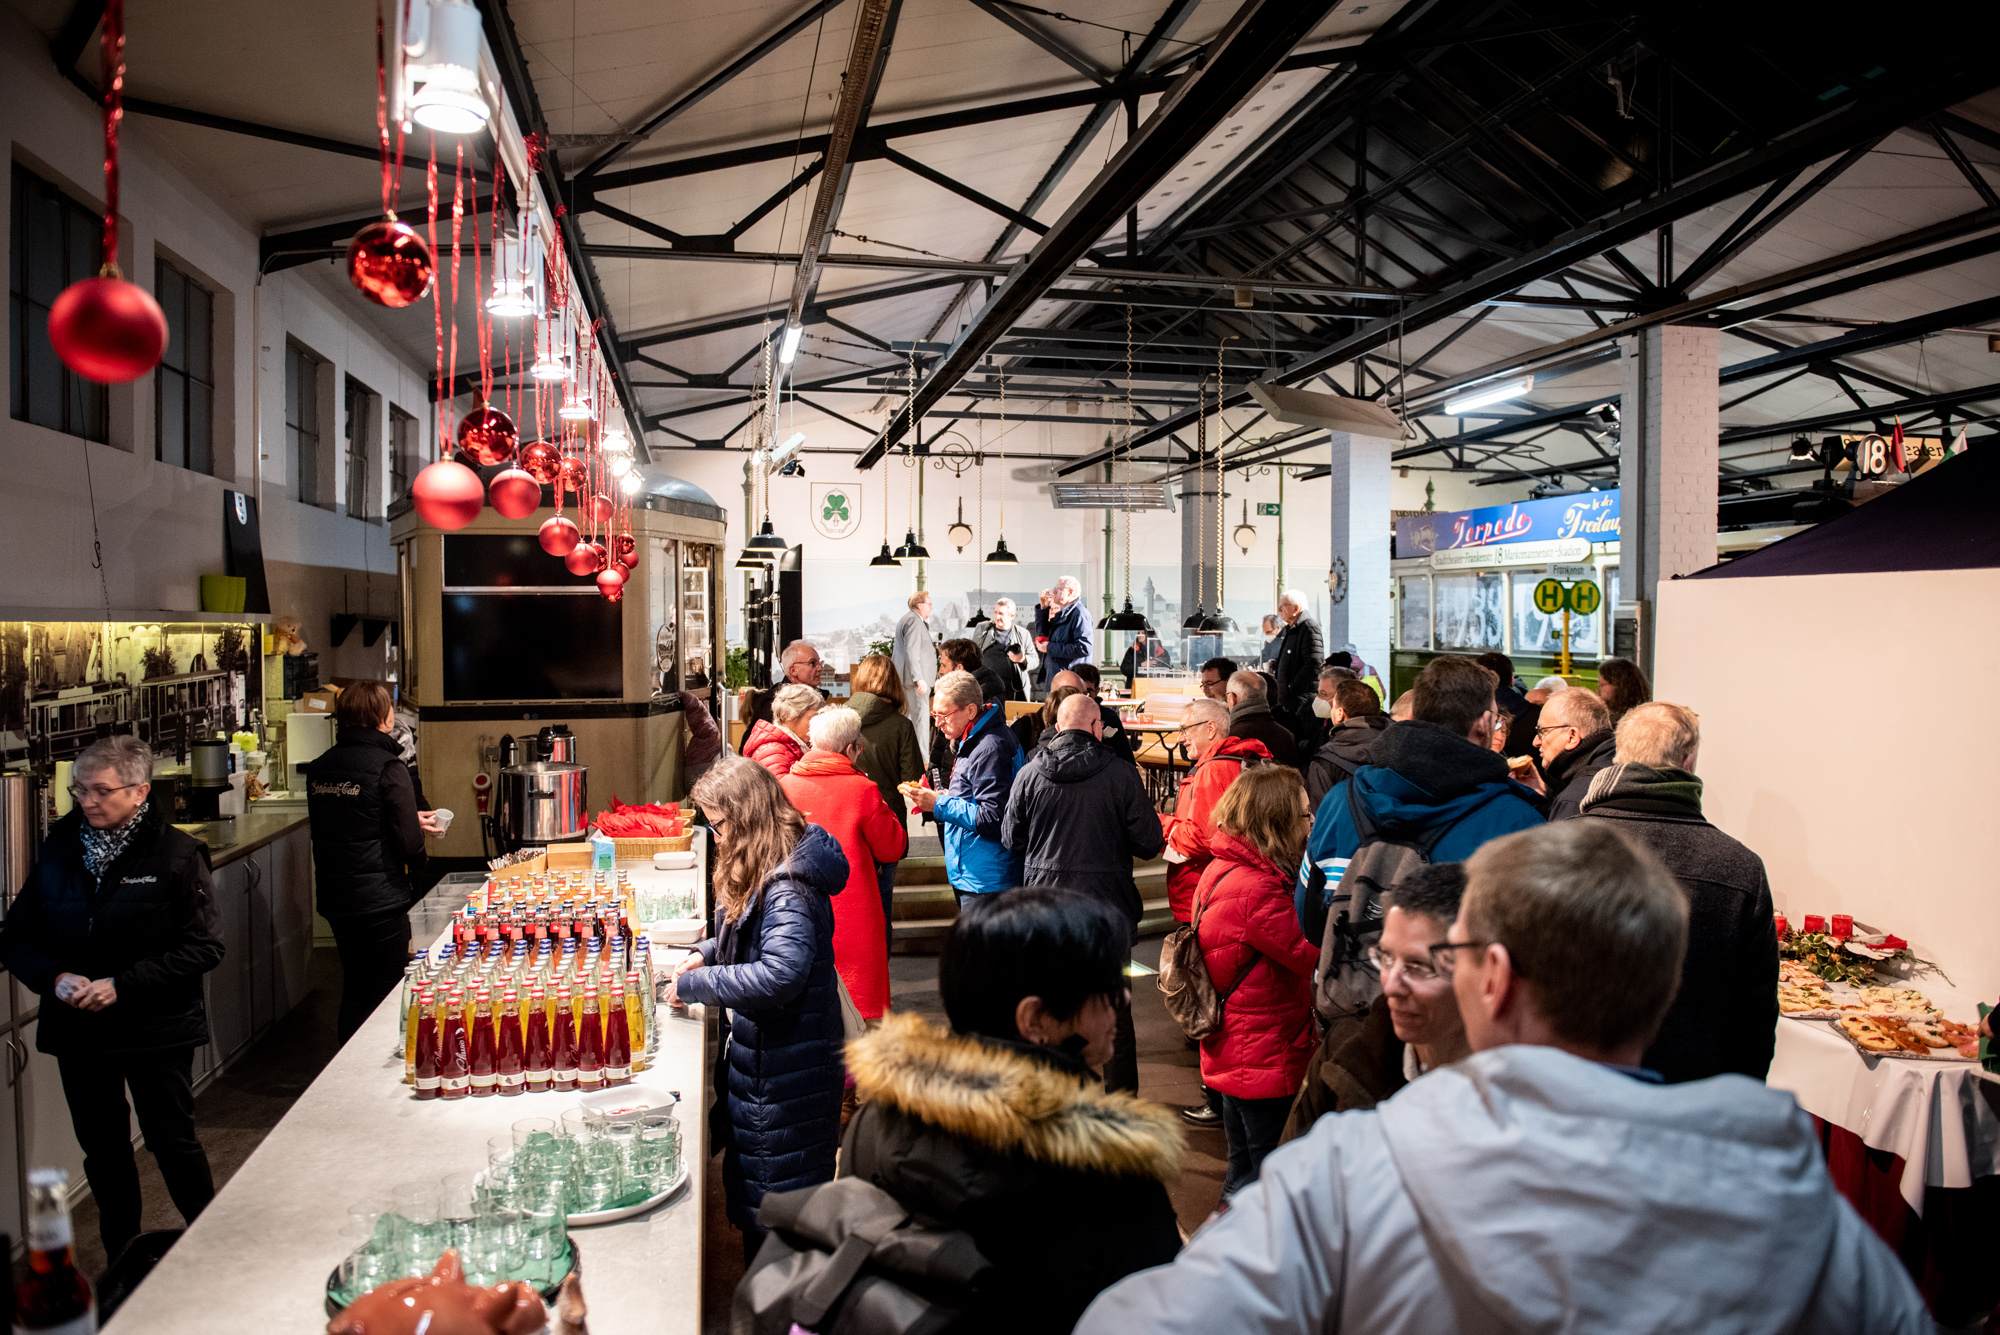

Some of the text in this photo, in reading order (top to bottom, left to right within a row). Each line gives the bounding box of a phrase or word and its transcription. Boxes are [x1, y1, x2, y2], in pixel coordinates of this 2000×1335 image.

[1863, 439, 1886, 474] 18
[1449, 504, 1533, 549] Torpedo
[1494, 547, 1503, 565] 18
[1542, 585, 1593, 609] H H
